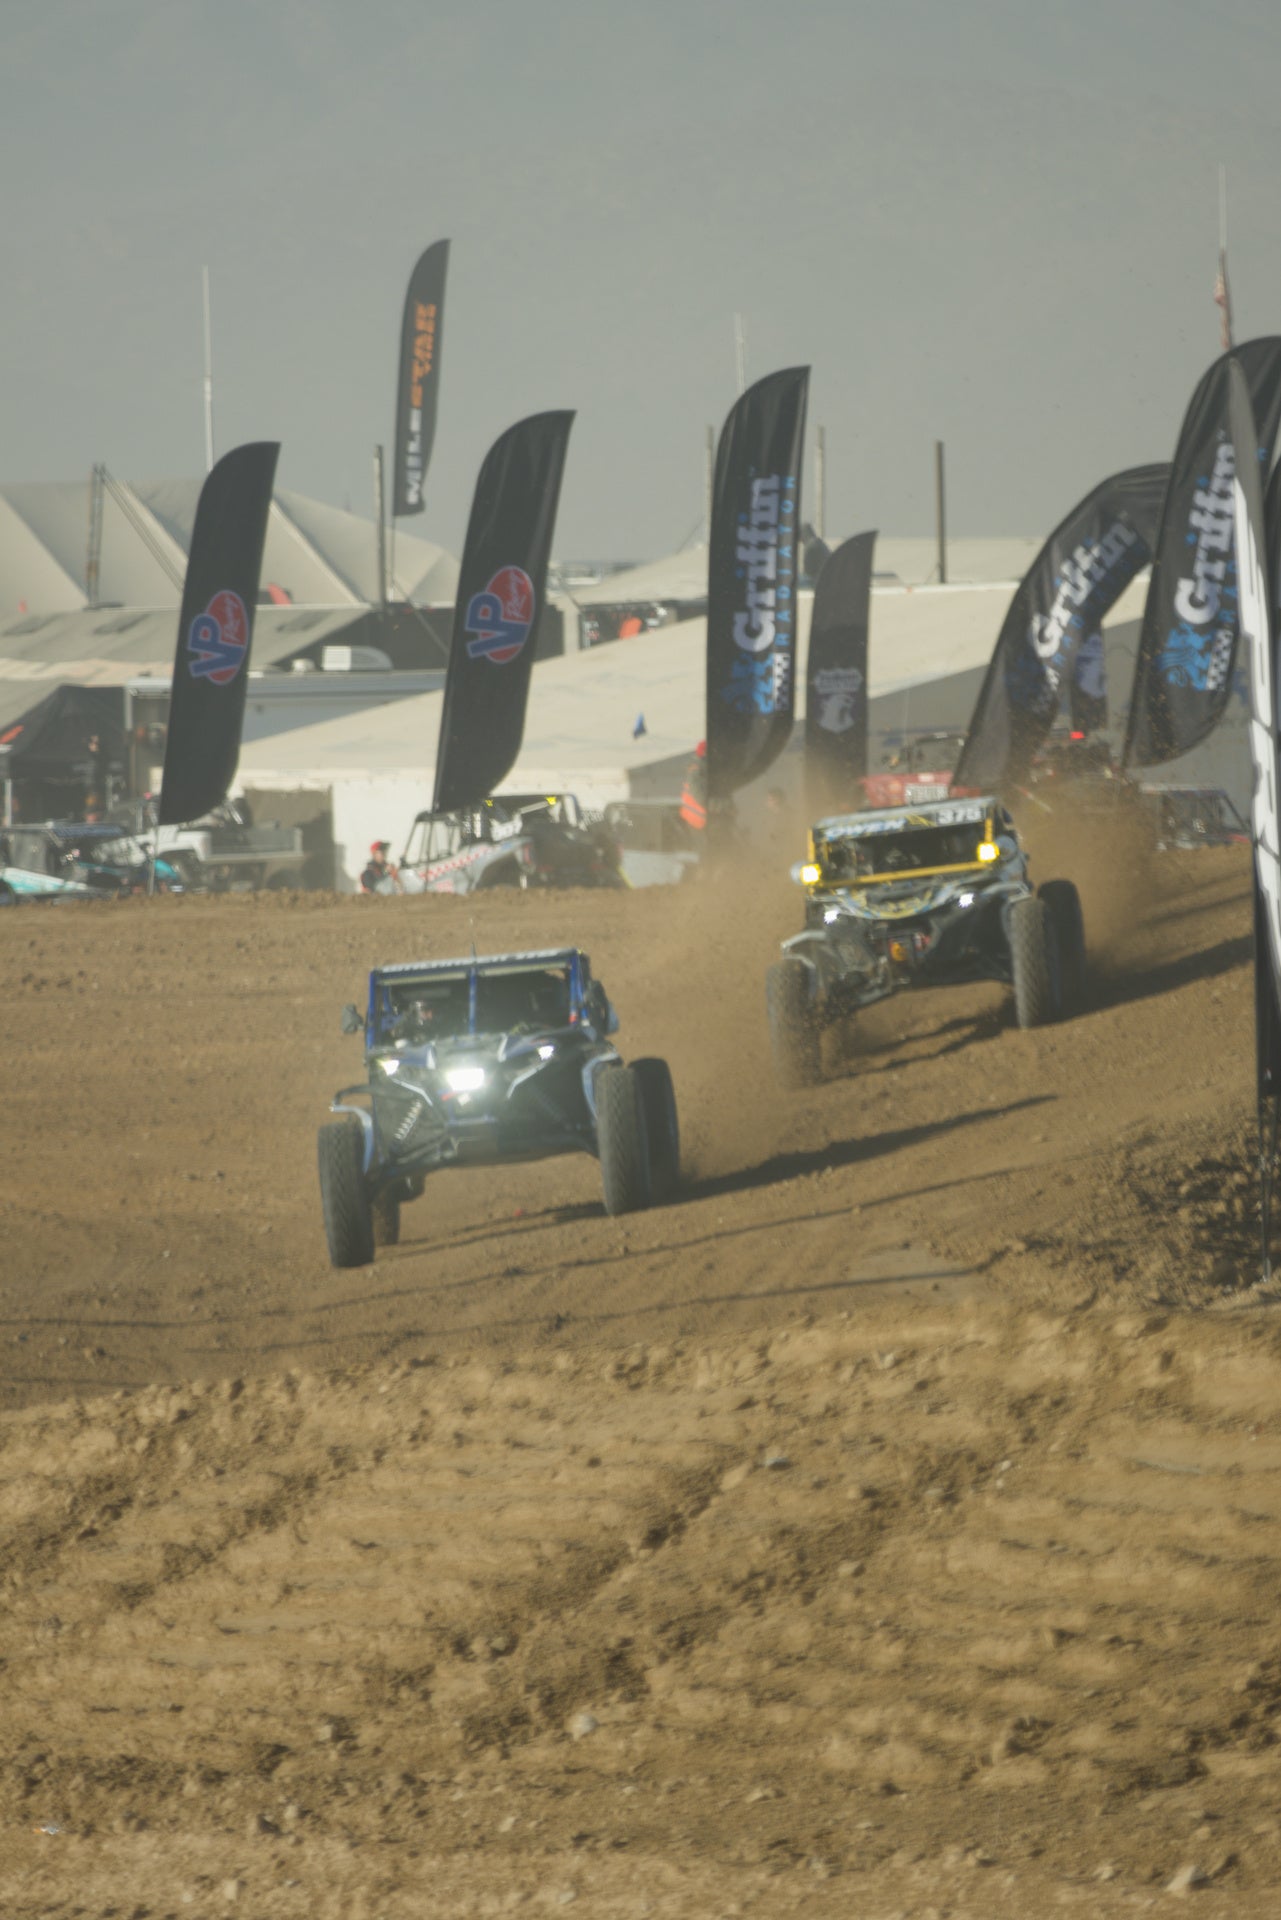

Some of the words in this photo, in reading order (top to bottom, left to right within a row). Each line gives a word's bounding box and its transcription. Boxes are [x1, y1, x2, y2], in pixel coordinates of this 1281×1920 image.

[465, 592, 530, 658] VP
[733, 474, 780, 652] Griffin
[774, 476, 796, 646] RADIATOR
[1032, 522, 1138, 658] Griffin
[187, 613, 246, 677] VP
